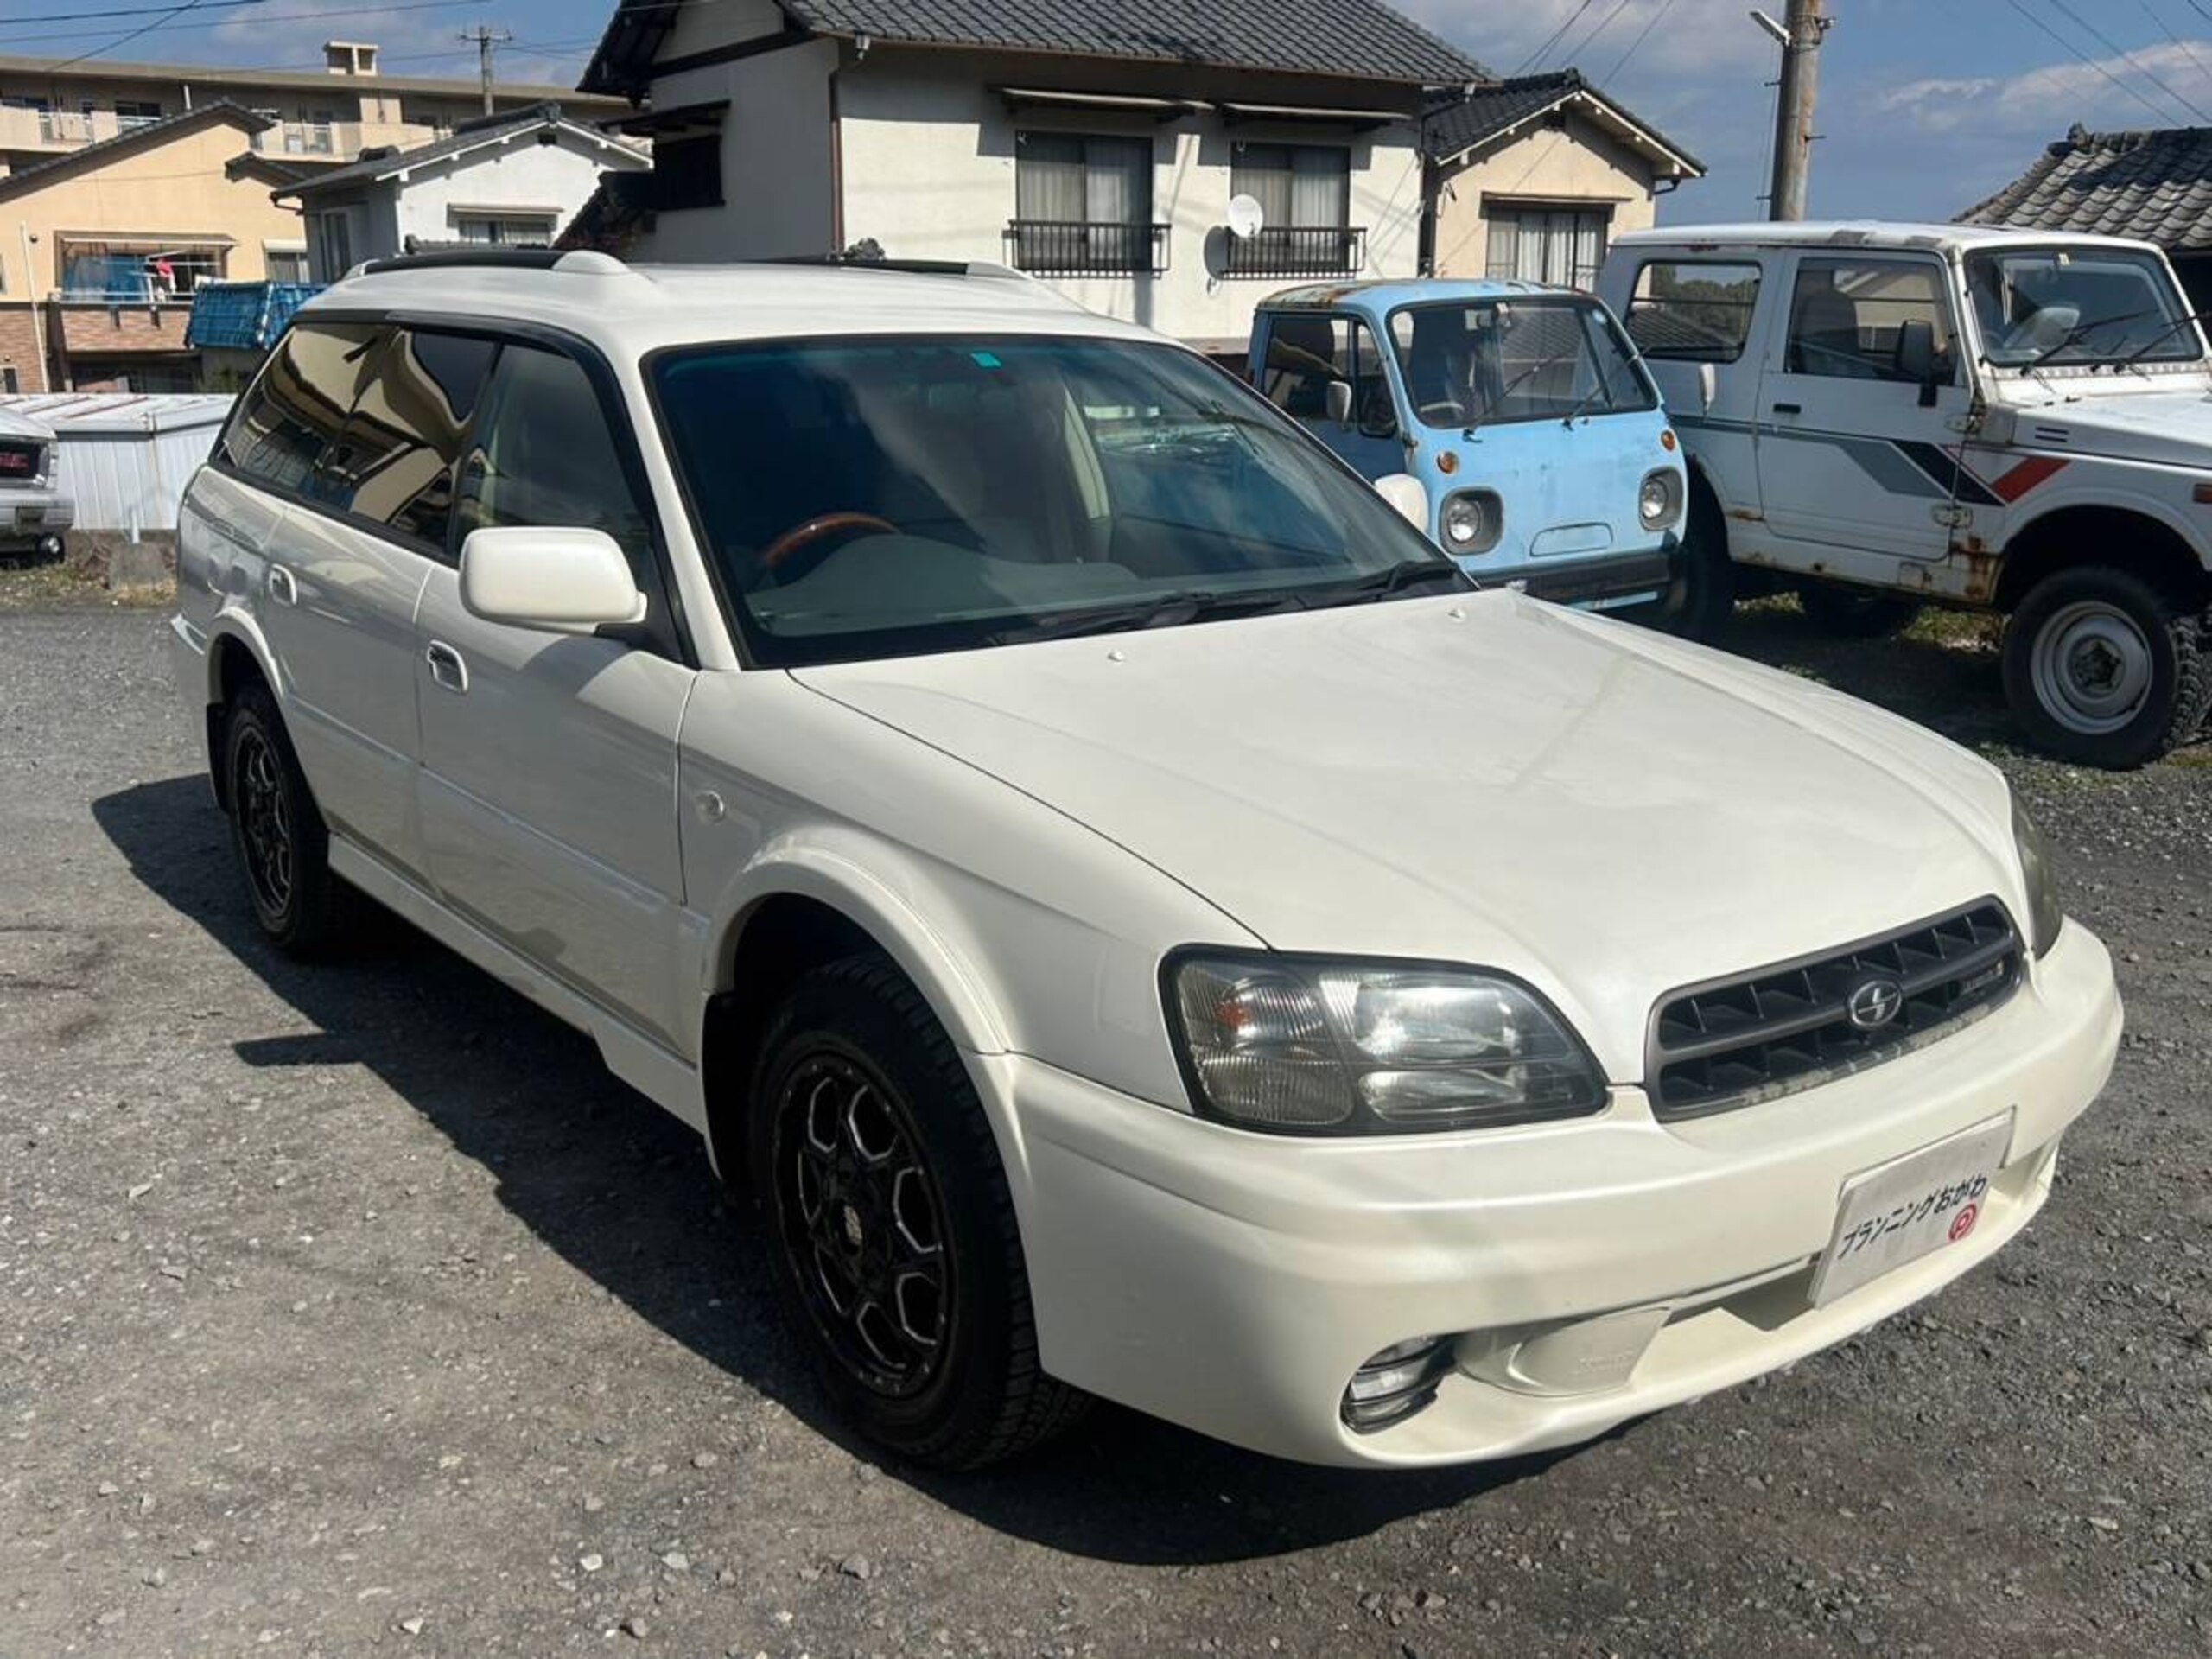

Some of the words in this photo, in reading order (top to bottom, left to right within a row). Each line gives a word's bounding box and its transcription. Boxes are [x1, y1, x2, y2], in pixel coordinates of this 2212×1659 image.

[1837, 1173, 1987, 1260] プランニングおがわ
